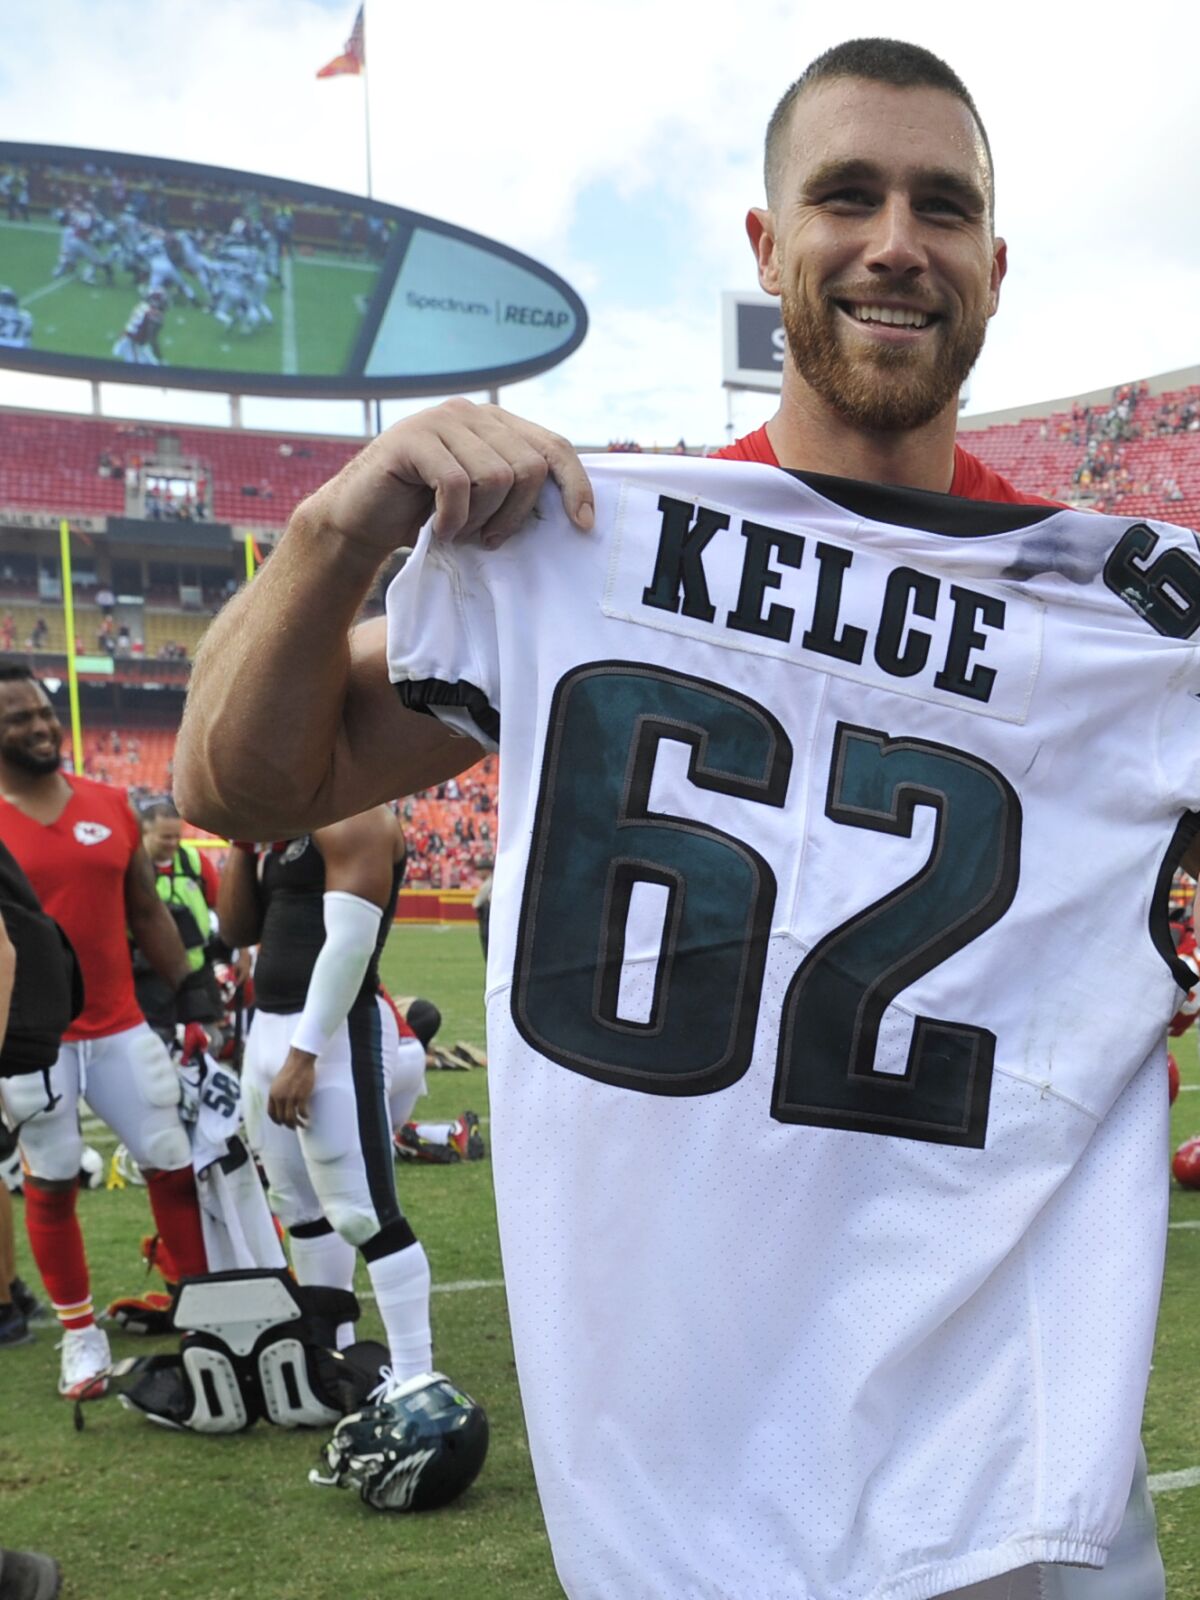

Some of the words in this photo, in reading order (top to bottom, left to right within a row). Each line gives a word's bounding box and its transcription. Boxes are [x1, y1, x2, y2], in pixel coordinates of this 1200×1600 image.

[406, 290, 491, 316] Spectrum
[505, 304, 569, 329] RECAP
[642, 494, 1006, 704] KELCE
[510, 659, 1022, 1149] 62
[203, 1071, 241, 1118] 58
